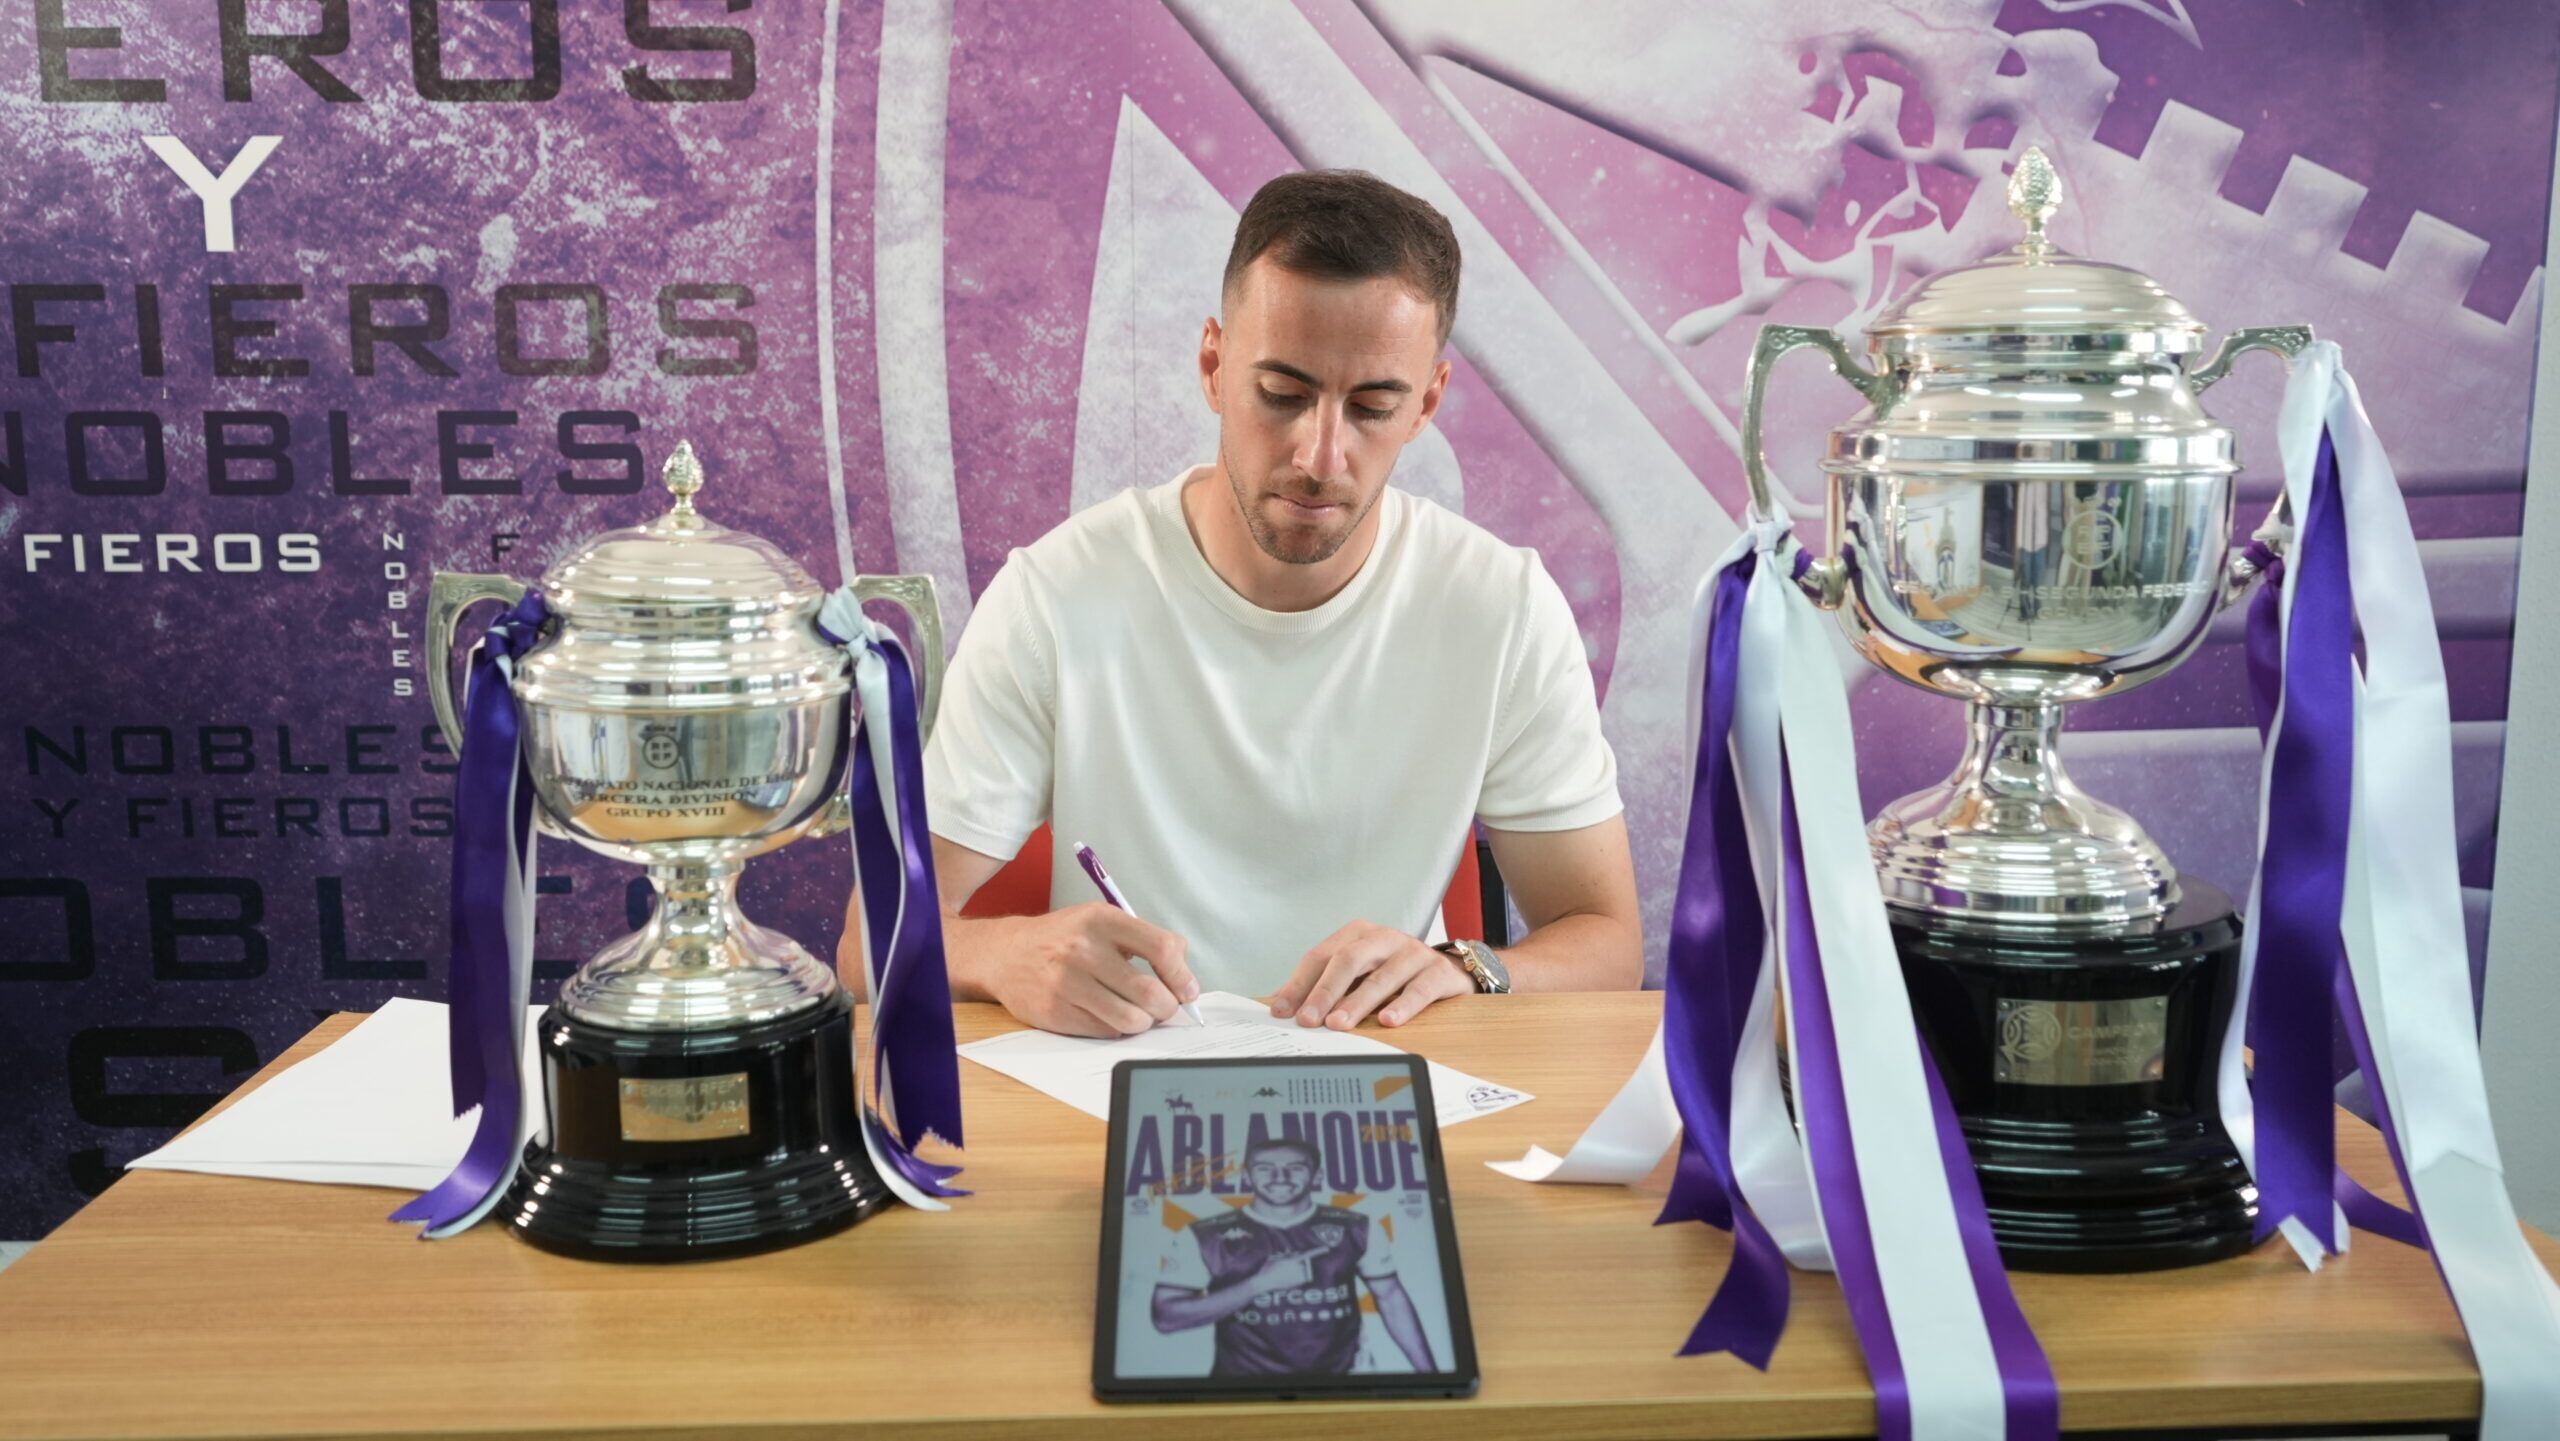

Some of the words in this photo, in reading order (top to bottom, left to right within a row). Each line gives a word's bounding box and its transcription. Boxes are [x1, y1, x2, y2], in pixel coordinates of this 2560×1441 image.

[142, 135, 284, 252] Y
[9, 283, 759, 378] FIEROS
[0, 410, 644, 497] OBLES
[22, 533, 321, 573] FIEROS
[383, 532, 412, 696] NOBLES
[24, 725, 459, 775] NOBLES
[642, 778, 731, 791] NACIONAL
[33, 799, 80, 838] Y
[127, 797, 455, 838] FIEROS
[605, 807, 672, 818] GRUPO
[677, 806, 726, 817] XVIII
